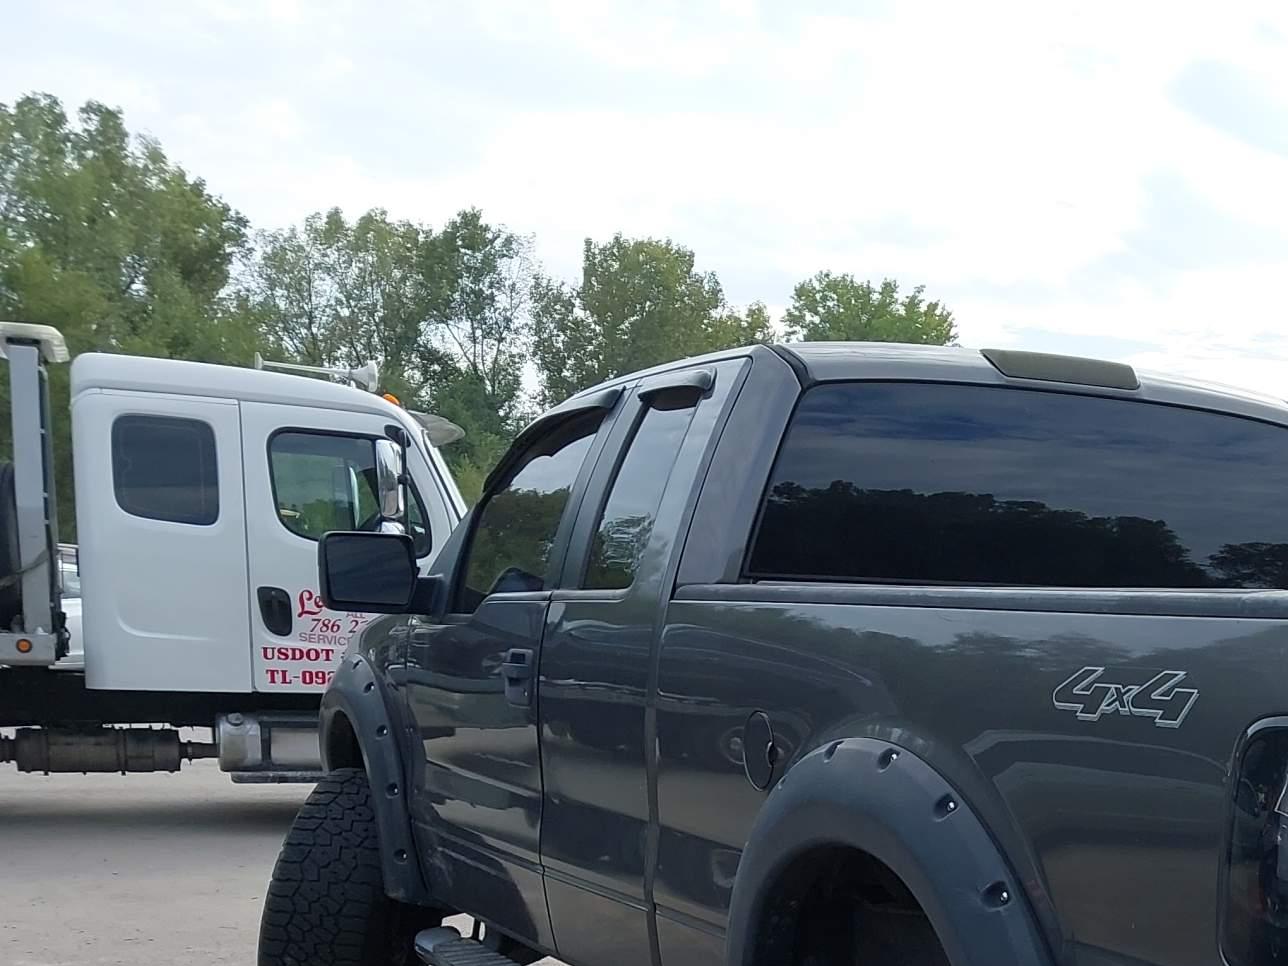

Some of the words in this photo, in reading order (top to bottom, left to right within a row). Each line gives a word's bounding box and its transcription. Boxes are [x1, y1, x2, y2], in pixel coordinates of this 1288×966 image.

[297, 589, 324, 618] Le
[310, 618, 342, 634] 786
[261, 646, 335, 662] USDOT
[1052, 666, 1200, 729] 4x4
